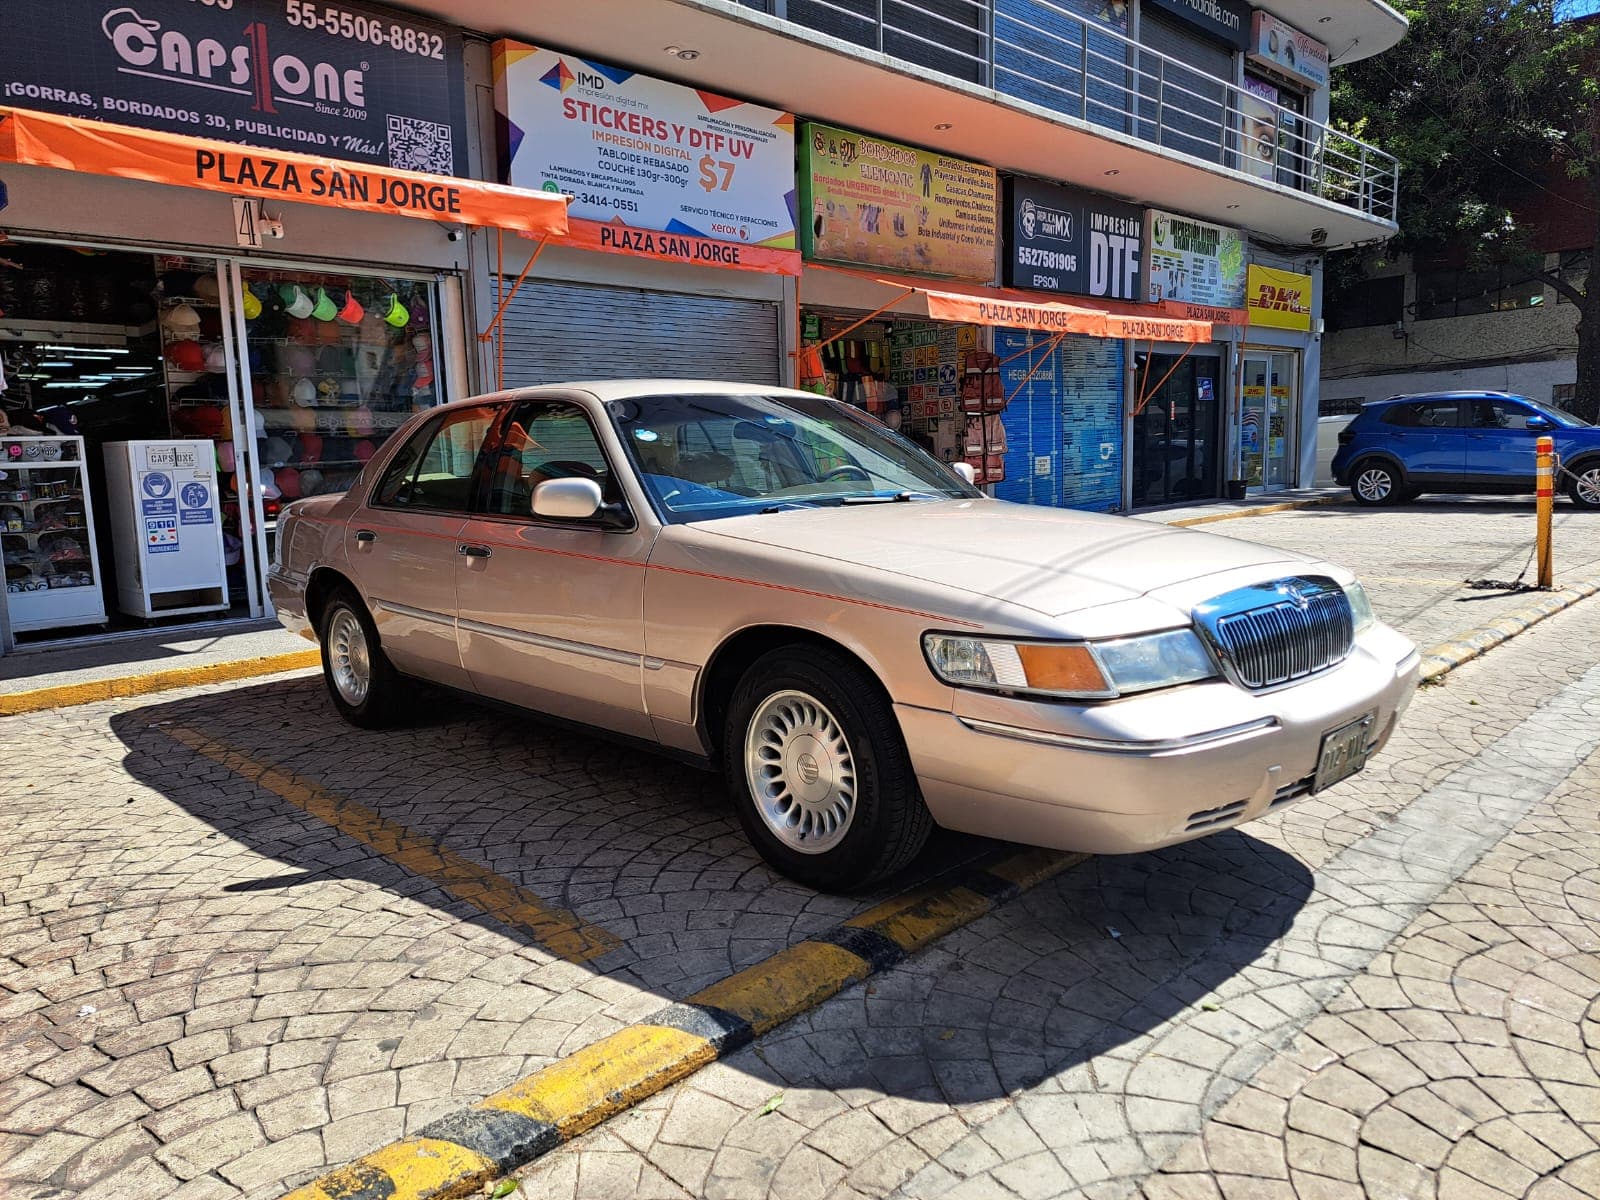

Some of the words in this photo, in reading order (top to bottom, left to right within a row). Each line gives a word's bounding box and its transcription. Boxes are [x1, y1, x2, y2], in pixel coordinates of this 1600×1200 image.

[286, 0, 444, 60] 55-5506-8832
[577, 71, 604, 90] IMD
[315, 101, 340, 116] Since
[343, 107, 368, 120] 2009
[615, 94, 637, 108] digital
[4, 82, 98, 109] ¡GORRAS,
[103, 96, 200, 124] BORDADOS
[205, 114, 231, 132] 3D,
[235, 119, 327, 145] PUBLICIDAD
[330, 136, 340, 147] Y
[344, 135, 384, 155] Más!
[563, 97, 668, 141] STICKERS
[671, 123, 686, 144] Y
[689, 128, 724, 153] DTF
[728, 138, 754, 160] UV
[697, 114, 730, 127] SUBLIMACIÓN
[592, 131, 652, 153] IMPRESIÓN
[653, 143, 692, 161] DIGITAL
[859, 138, 917, 167] BORDADOS
[549, 164, 586, 177] LAMINADOS
[597, 146, 642, 164] TABLOIDE
[643, 156, 689, 174] REBASADO
[196, 149, 303, 193] PLAZA
[310, 168, 369, 202] SAN
[376, 177, 462, 213] JORGE
[540, 171, 559, 180] TINTA
[587, 180, 611, 190] BLANCA
[598, 160, 636, 176] COUCHÉ
[636, 168, 689, 188] 130gr-300gr
[698, 154, 736, 193] $7
[239, 200, 256, 246] 4
[680, 204, 709, 216] SERVICIO
[709, 208, 735, 221] TÉCNICO
[739, 215, 778, 228] REFACCIONES
[711, 223, 737, 235] xerox
[1055, 214, 1071, 238] MX
[1090, 212, 1140, 238] IMPRESIÓN
[1170, 218, 1201, 243] IMPRESIÓN
[600, 227, 655, 253] PLAZA
[659, 236, 690, 258] SAN
[693, 241, 741, 264] JORGE
[1190, 237, 1217, 257] FORMATO
[1018, 246, 1077, 272] 5527581905
[1089, 230, 1140, 299] DTF
[1033, 274, 1059, 289] EPSON
[979, 302, 1012, 322] PLAZA
[1015, 308, 1036, 325] SAN
[1037, 309, 1067, 328] JORGE
[1187, 306, 1203, 319] PLAZA
[1204, 308, 1214, 321] SAN
[1214, 310, 1230, 322] JORGE
[1122, 321, 1145, 336] PLAZA
[1145, 323, 1162, 337] SAN
[1162, 324, 1185, 338] JORGE
